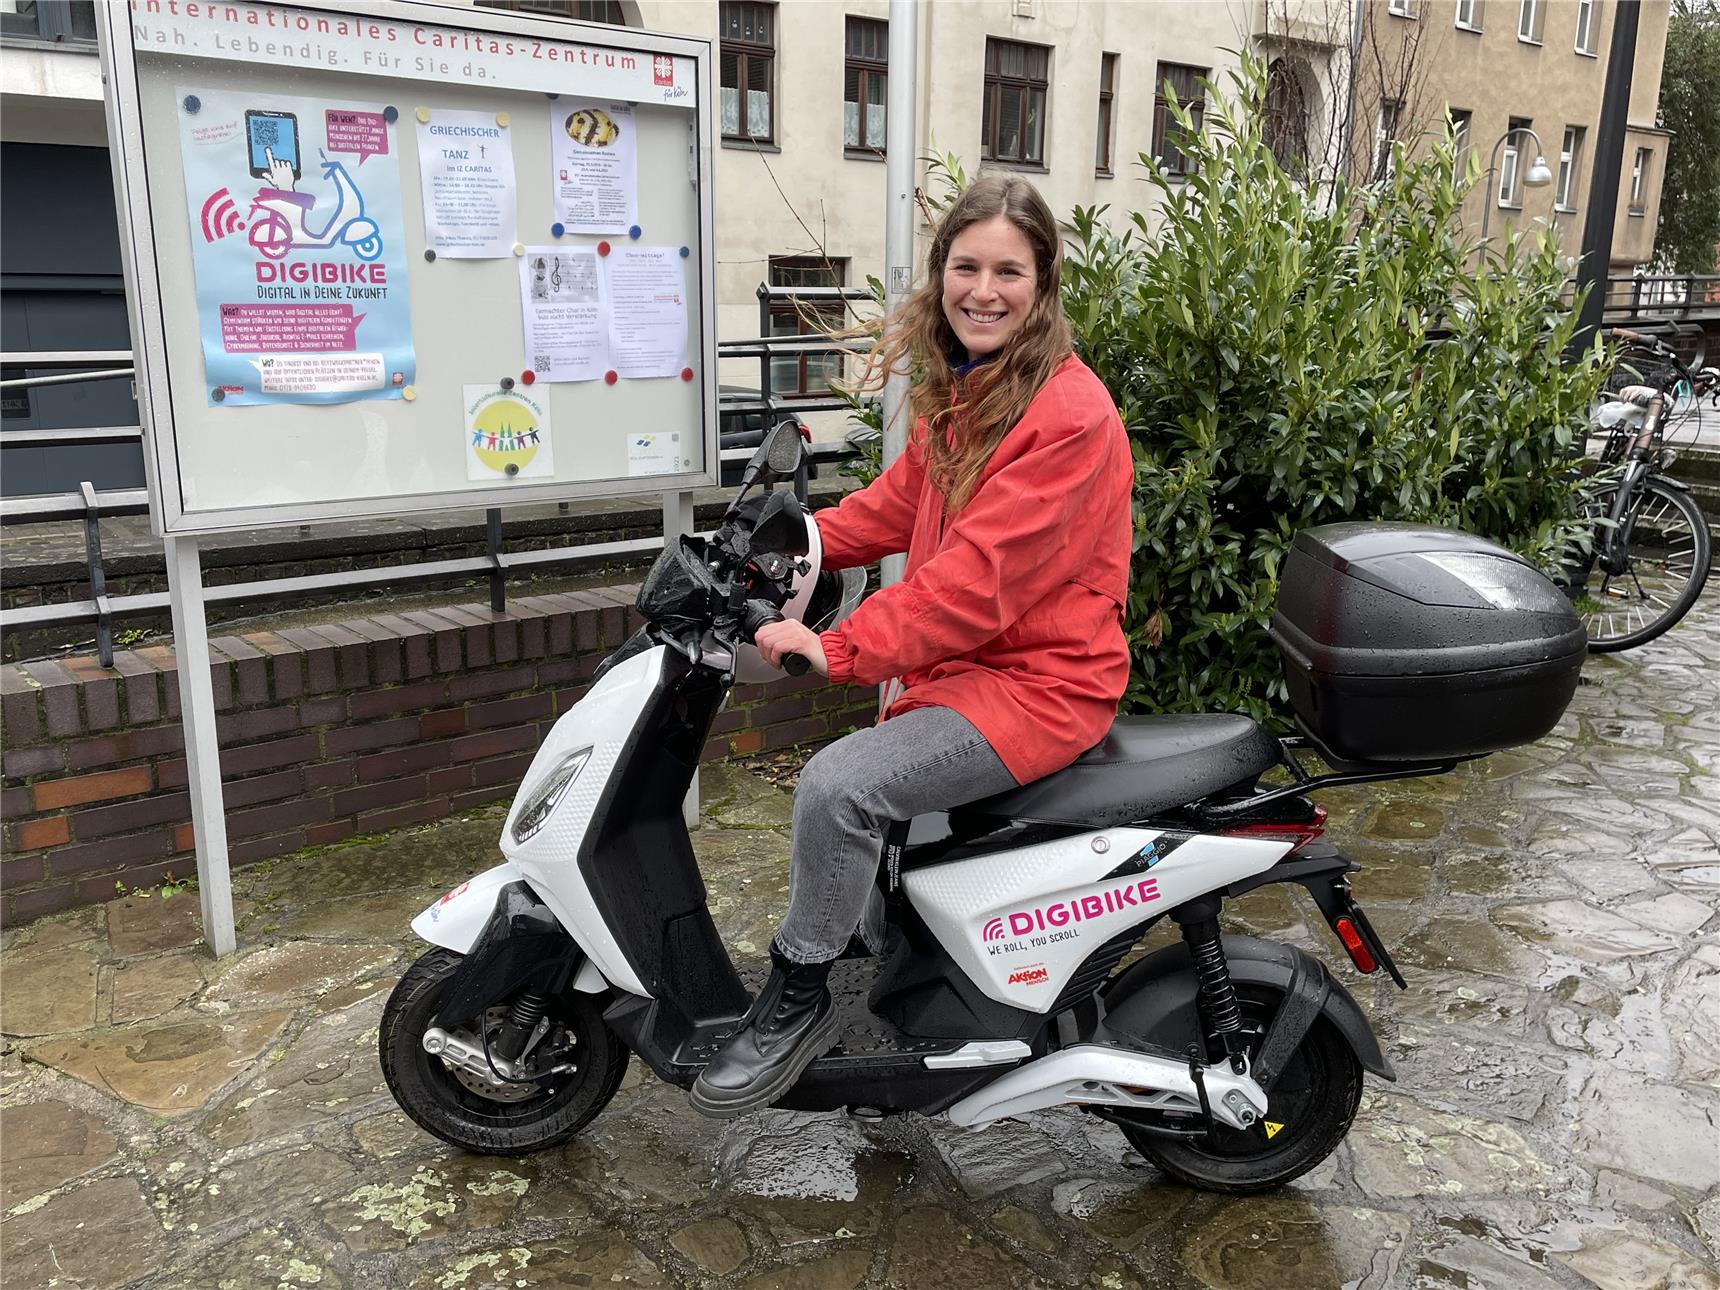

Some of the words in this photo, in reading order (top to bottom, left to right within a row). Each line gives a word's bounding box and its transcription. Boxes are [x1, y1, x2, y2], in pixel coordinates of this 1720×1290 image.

[132, 0, 397, 41] Internationales
[413, 27, 636, 70] Caritas-Zentrum
[134, 25, 199, 47] Nah.
[215, 34, 349, 65] Lebendig.
[364, 50, 401, 69] Für
[415, 57, 449, 75] Sie
[463, 63, 496, 80] da.
[430, 125, 500, 138] GRIECHISCHER
[441, 149, 470, 160] TANZ
[464, 165, 493, 173] CARITAS
[256, 261, 387, 284] DIGIBIKE
[257, 285, 297, 299] DIGITAL
[300, 287, 311, 299] IN
[314, 286, 342, 299] DEINE
[346, 286, 388, 299] ZUKUNFT
[1136, 842, 1167, 868] PIAGGIO
[1008, 878, 1161, 937] DIGIBIKE
[987, 944, 1002, 956] WE
[1004, 940, 1028, 953] ROLL,
[1030, 937, 1047, 948] YOU
[1049, 928, 1080, 943] SCROLL
